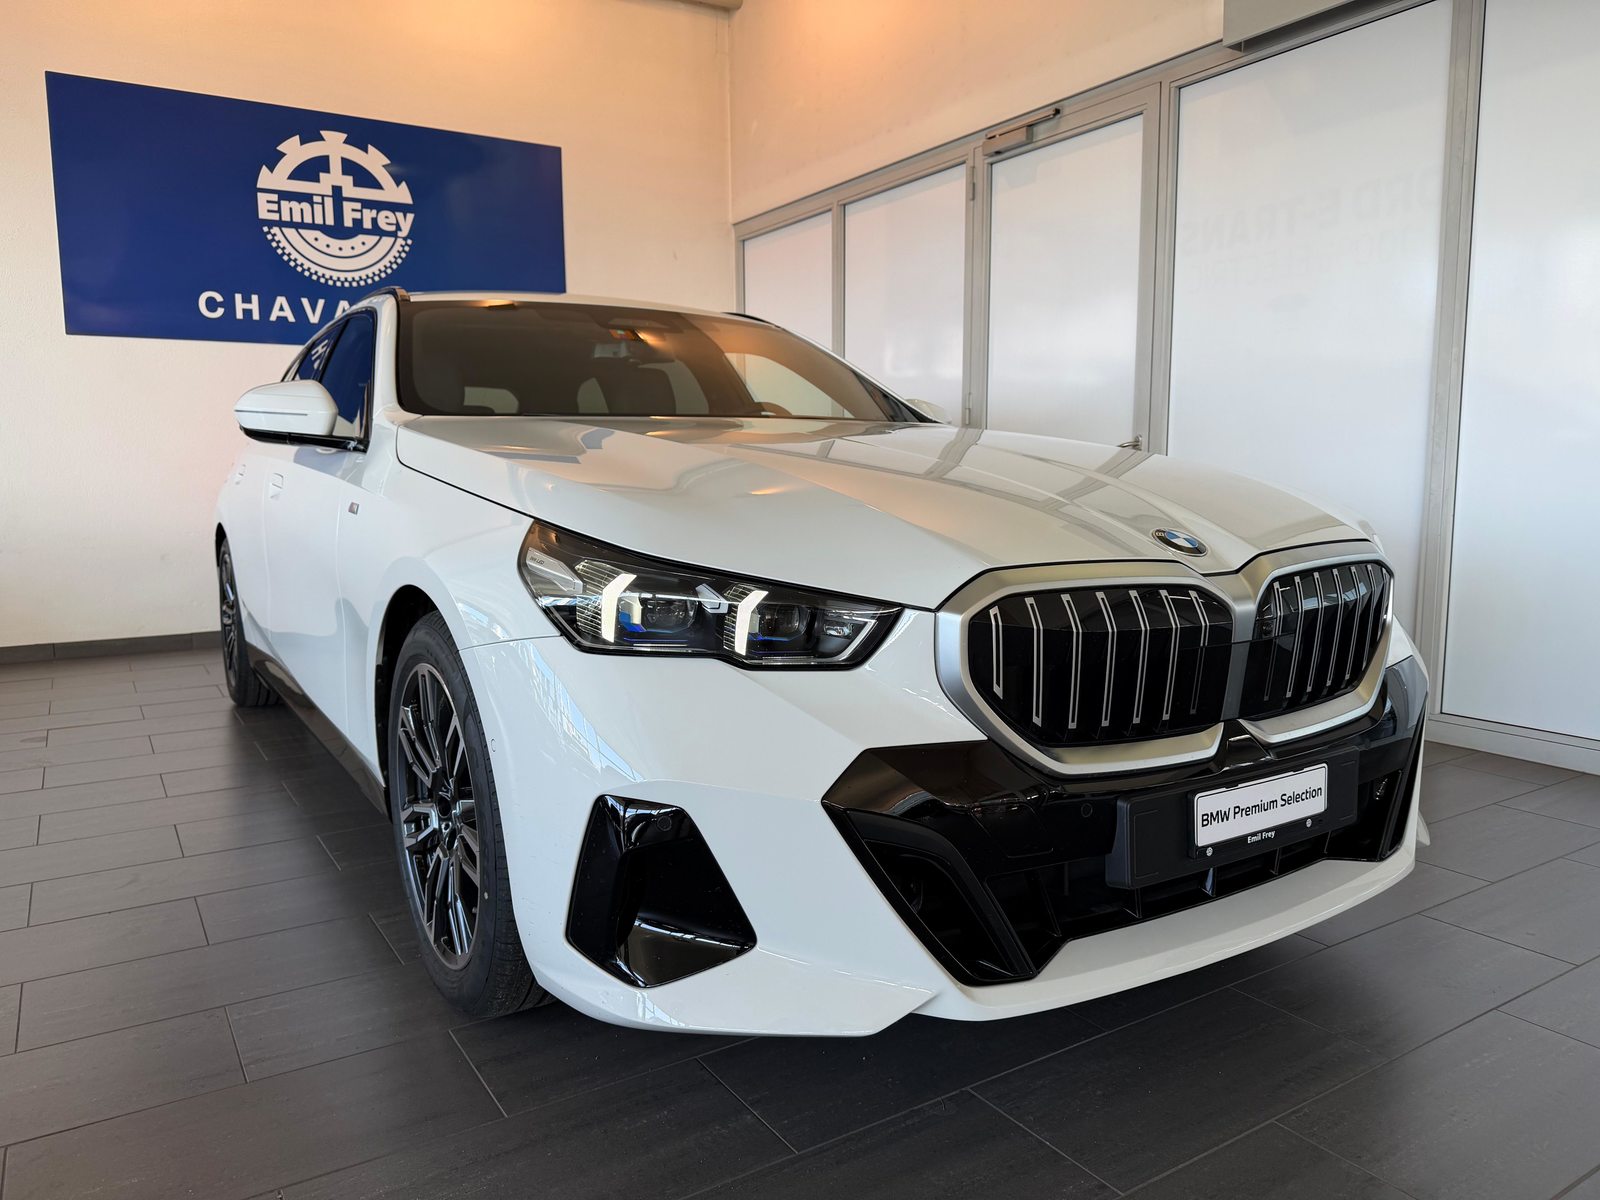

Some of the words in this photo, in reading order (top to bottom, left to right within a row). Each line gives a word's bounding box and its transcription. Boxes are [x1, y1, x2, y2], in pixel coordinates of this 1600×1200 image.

[256, 192, 335, 226] Emil
[342, 200, 415, 238] Frey
[1201, 807, 1231, 827] BMW
[1233, 799, 1278, 819] Premium
[1280, 787, 1323, 807] Selection
[1247, 833, 1261, 844] Emil
[1262, 830, 1276, 841] Frey
